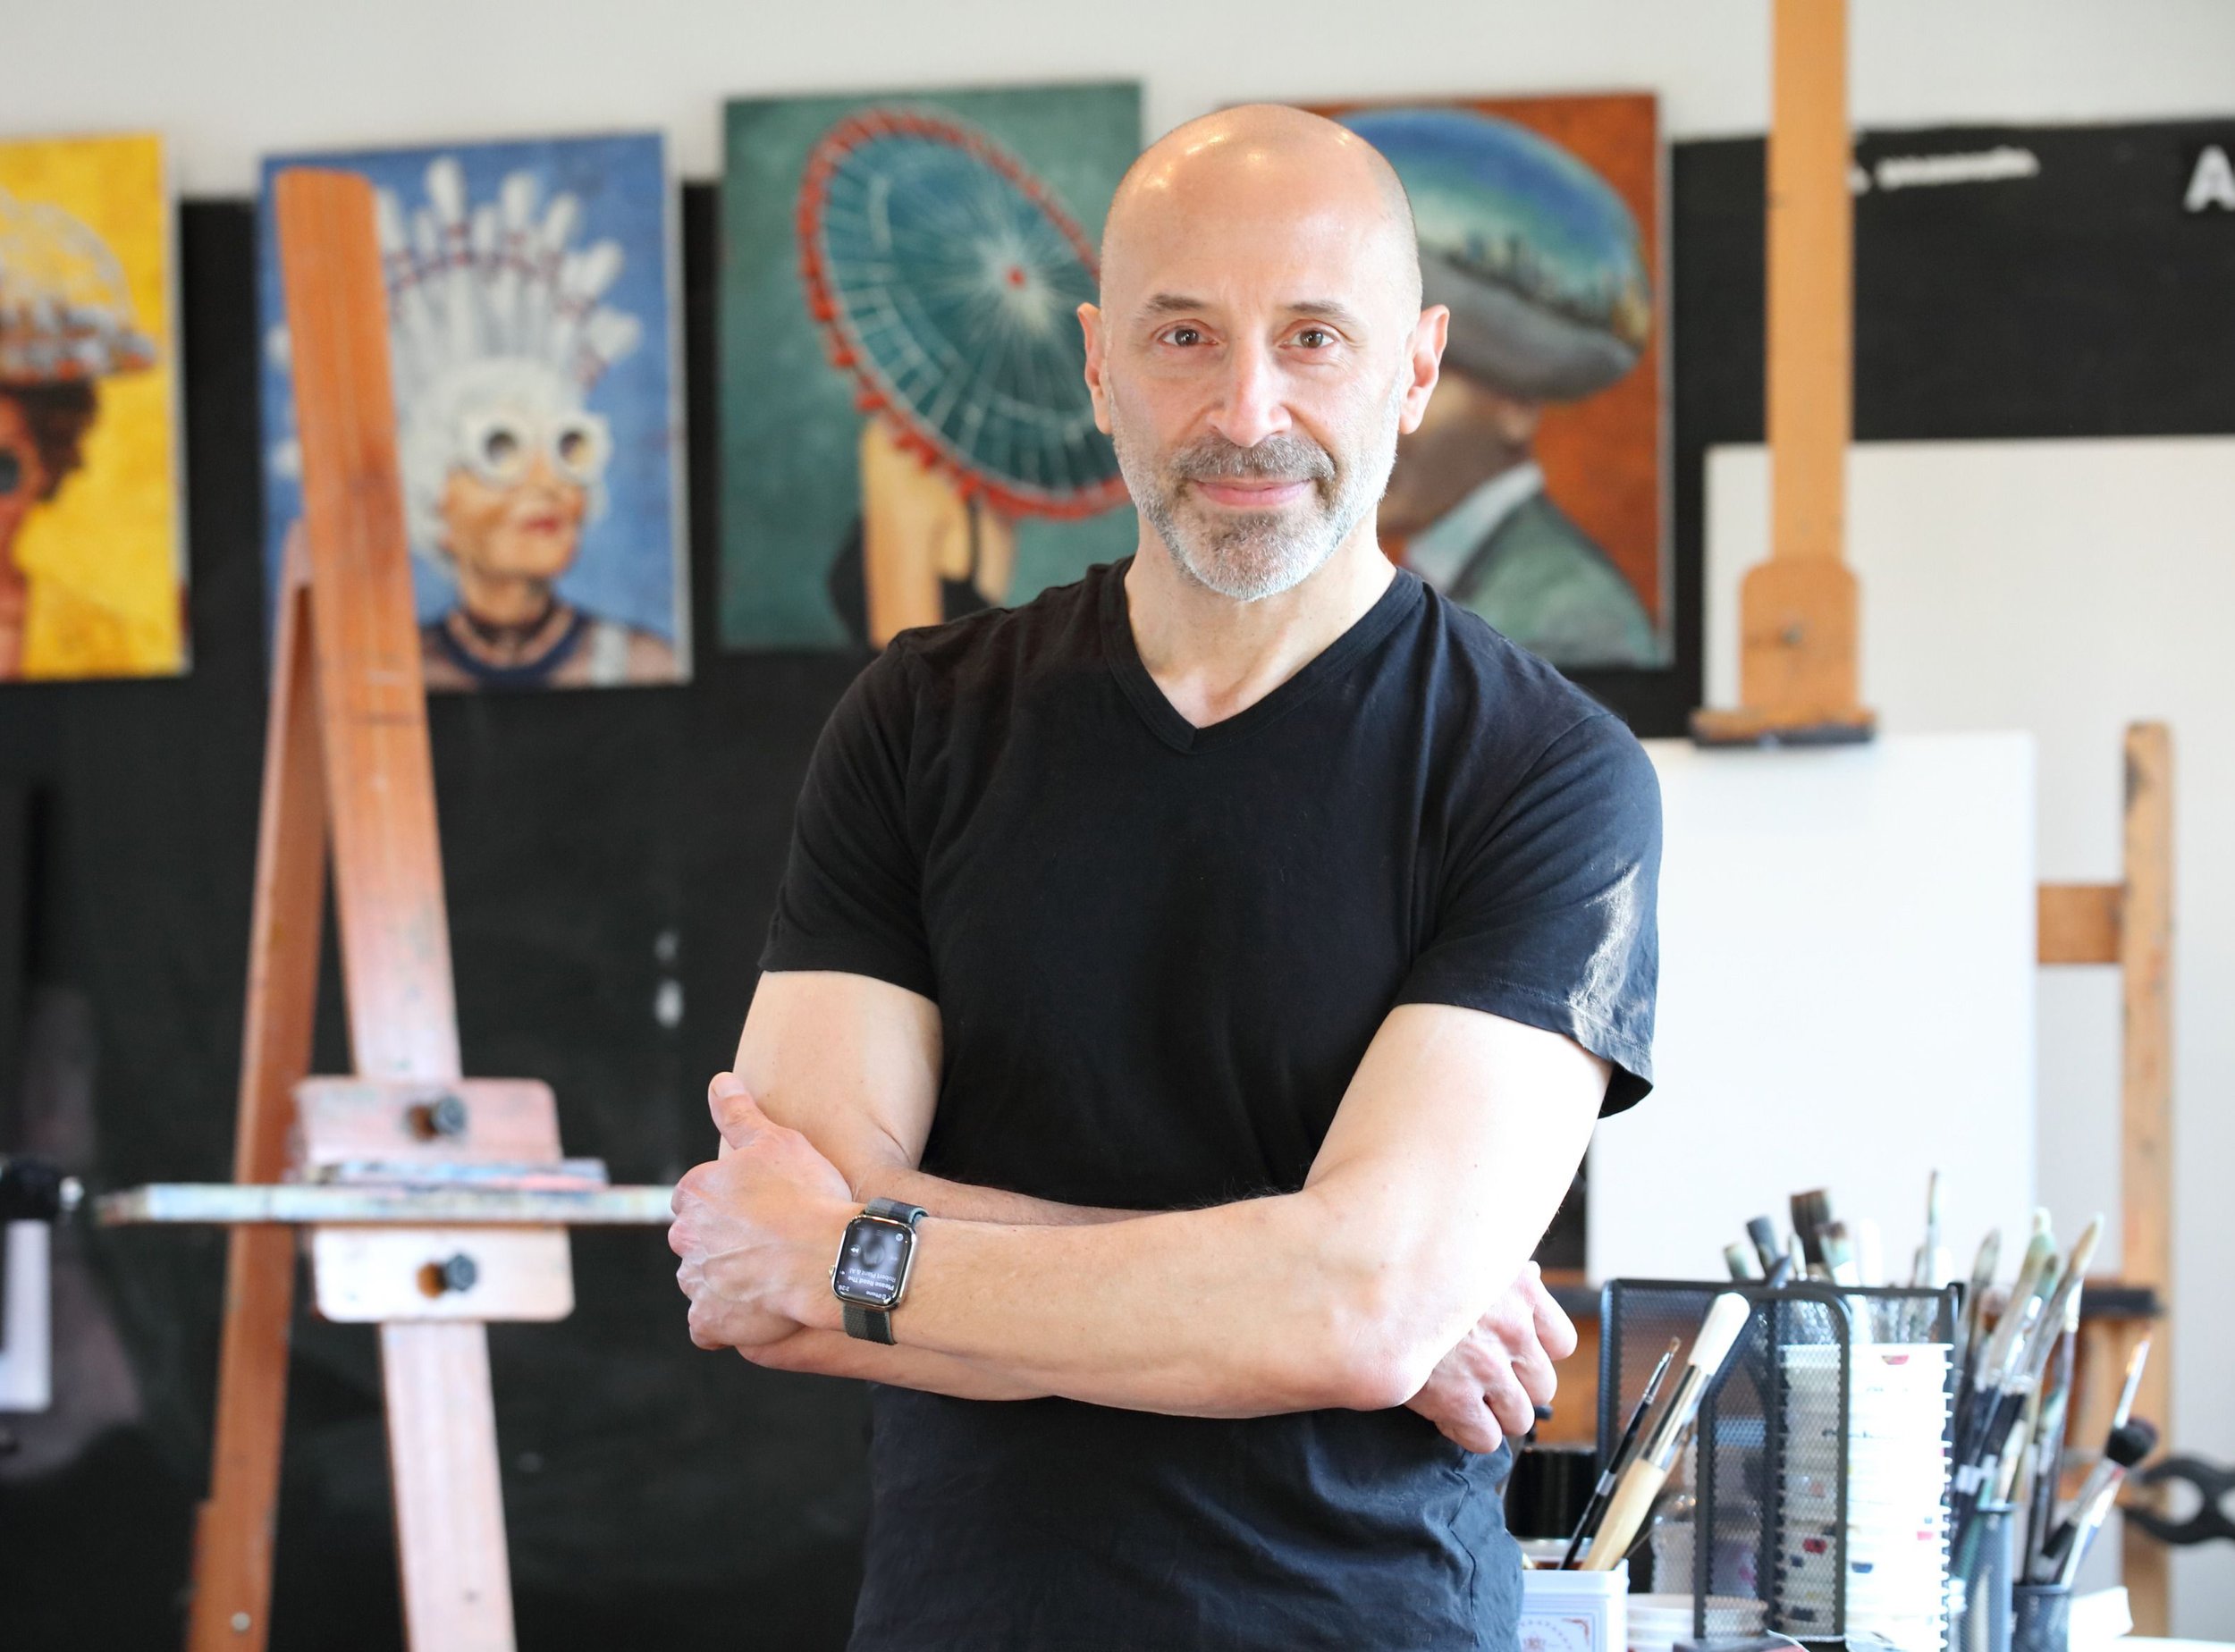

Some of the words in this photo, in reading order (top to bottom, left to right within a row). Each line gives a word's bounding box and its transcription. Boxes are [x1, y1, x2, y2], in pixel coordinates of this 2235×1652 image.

[858, 1277, 874, 1286] Read
[877, 1272, 896, 1283] Robert
[874, 1281, 894, 1291] Please
